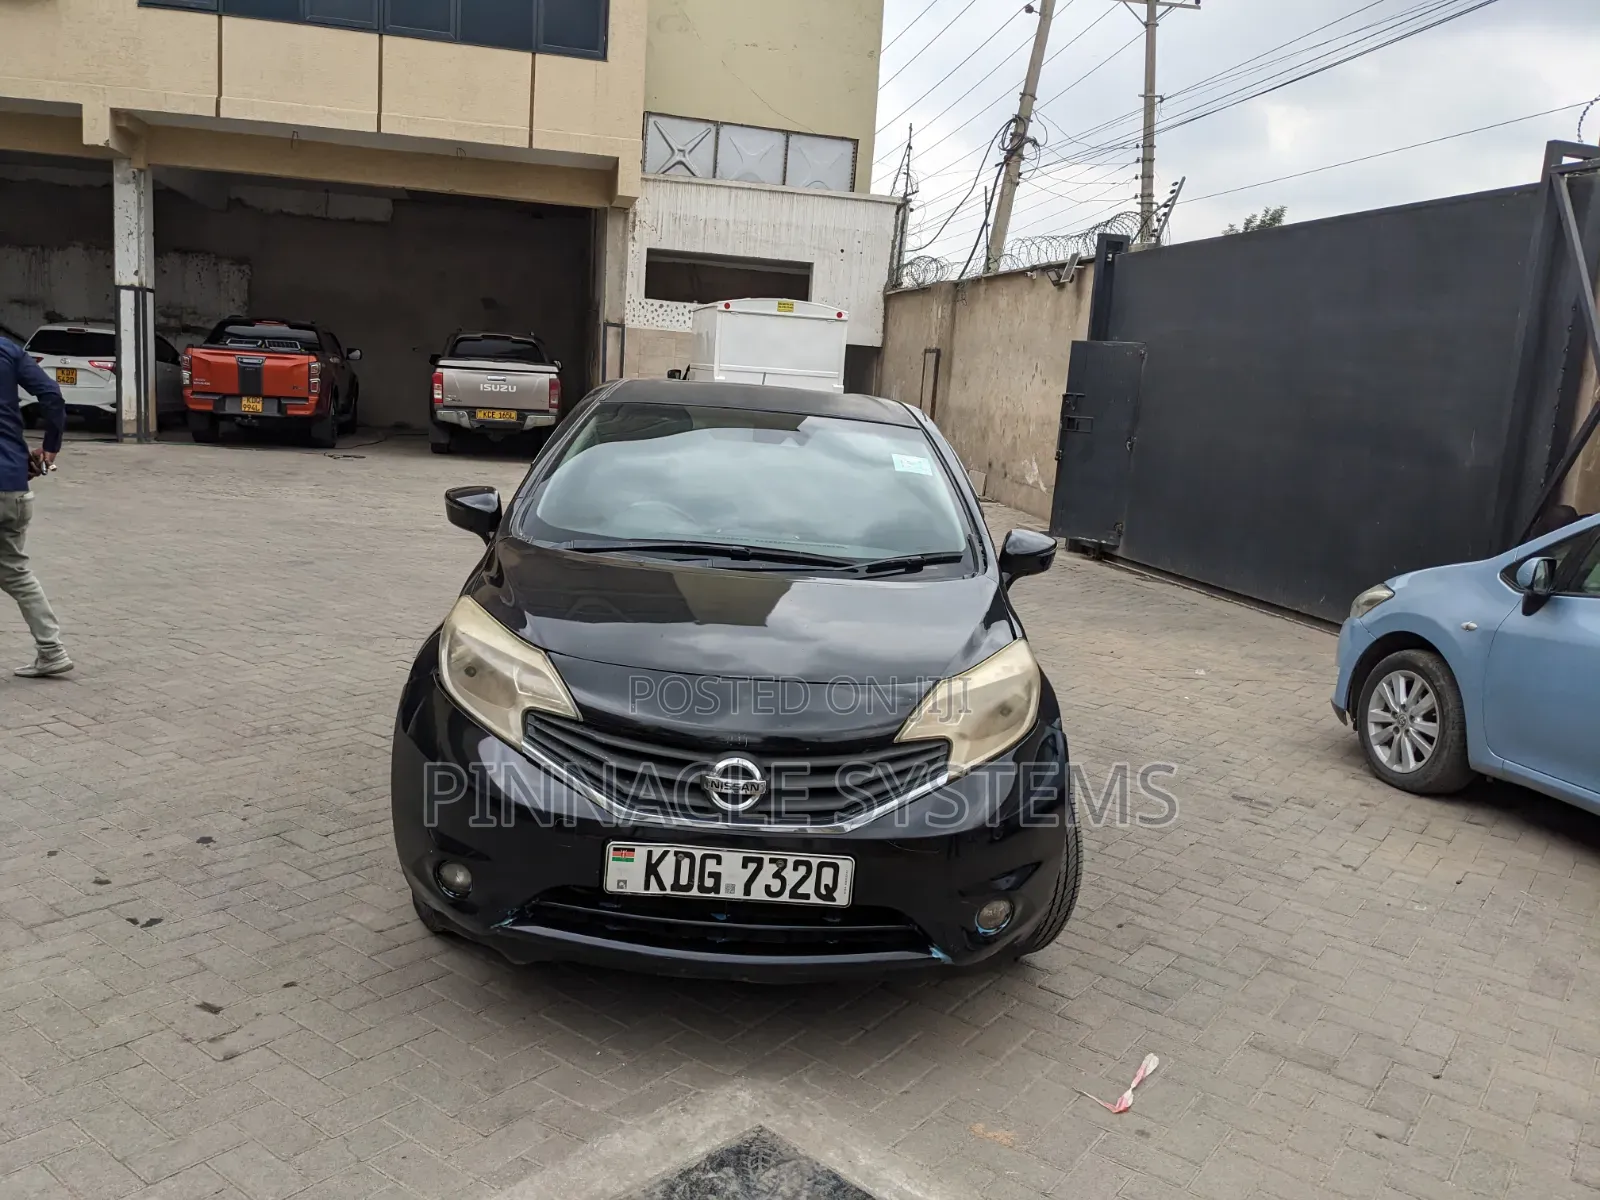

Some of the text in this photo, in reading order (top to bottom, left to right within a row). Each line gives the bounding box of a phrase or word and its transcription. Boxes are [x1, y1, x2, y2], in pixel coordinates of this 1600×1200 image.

[480, 383, 517, 393] ISUZU
[710, 780, 760, 792] NISSAN
[643, 849, 723, 894] KDG
[741, 855, 840, 902] 732Q
